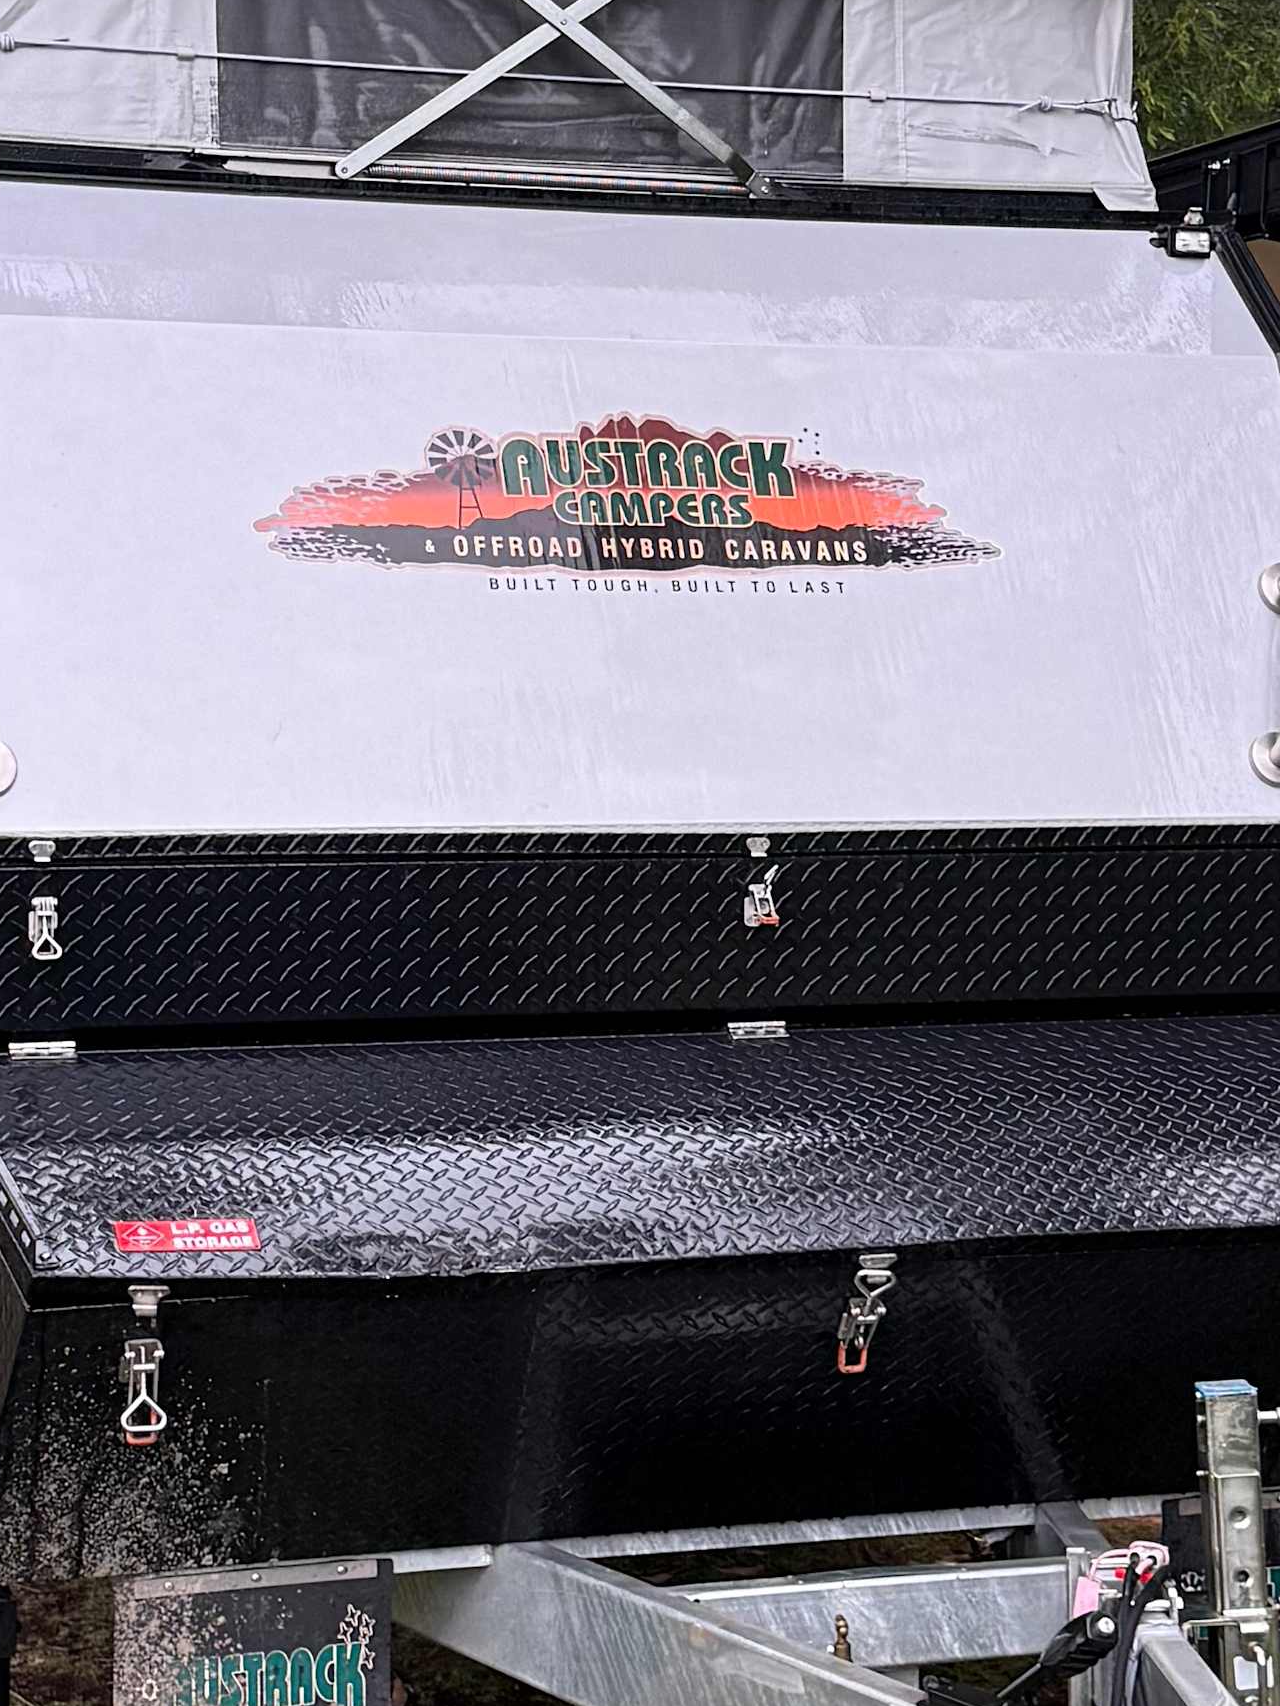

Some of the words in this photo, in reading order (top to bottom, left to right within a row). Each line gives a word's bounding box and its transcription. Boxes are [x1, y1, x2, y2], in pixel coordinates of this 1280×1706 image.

[502, 437, 796, 498] AUSTRACK
[552, 490, 757, 528] CAMPERS
[425, 539, 436, 554] &
[453, 534, 583, 559] OFFROAD
[601, 536, 705, 560] HYBRID
[725, 538, 868, 563] CARAVANS
[489, 578, 557, 592] BUILT
[672, 580, 736, 593] BUILT
[752, 580, 776, 593] TO
[789, 581, 845, 594] LAST
[209, 1220, 250, 1233] GAS
[172, 1235, 255, 1248] STORAGE
